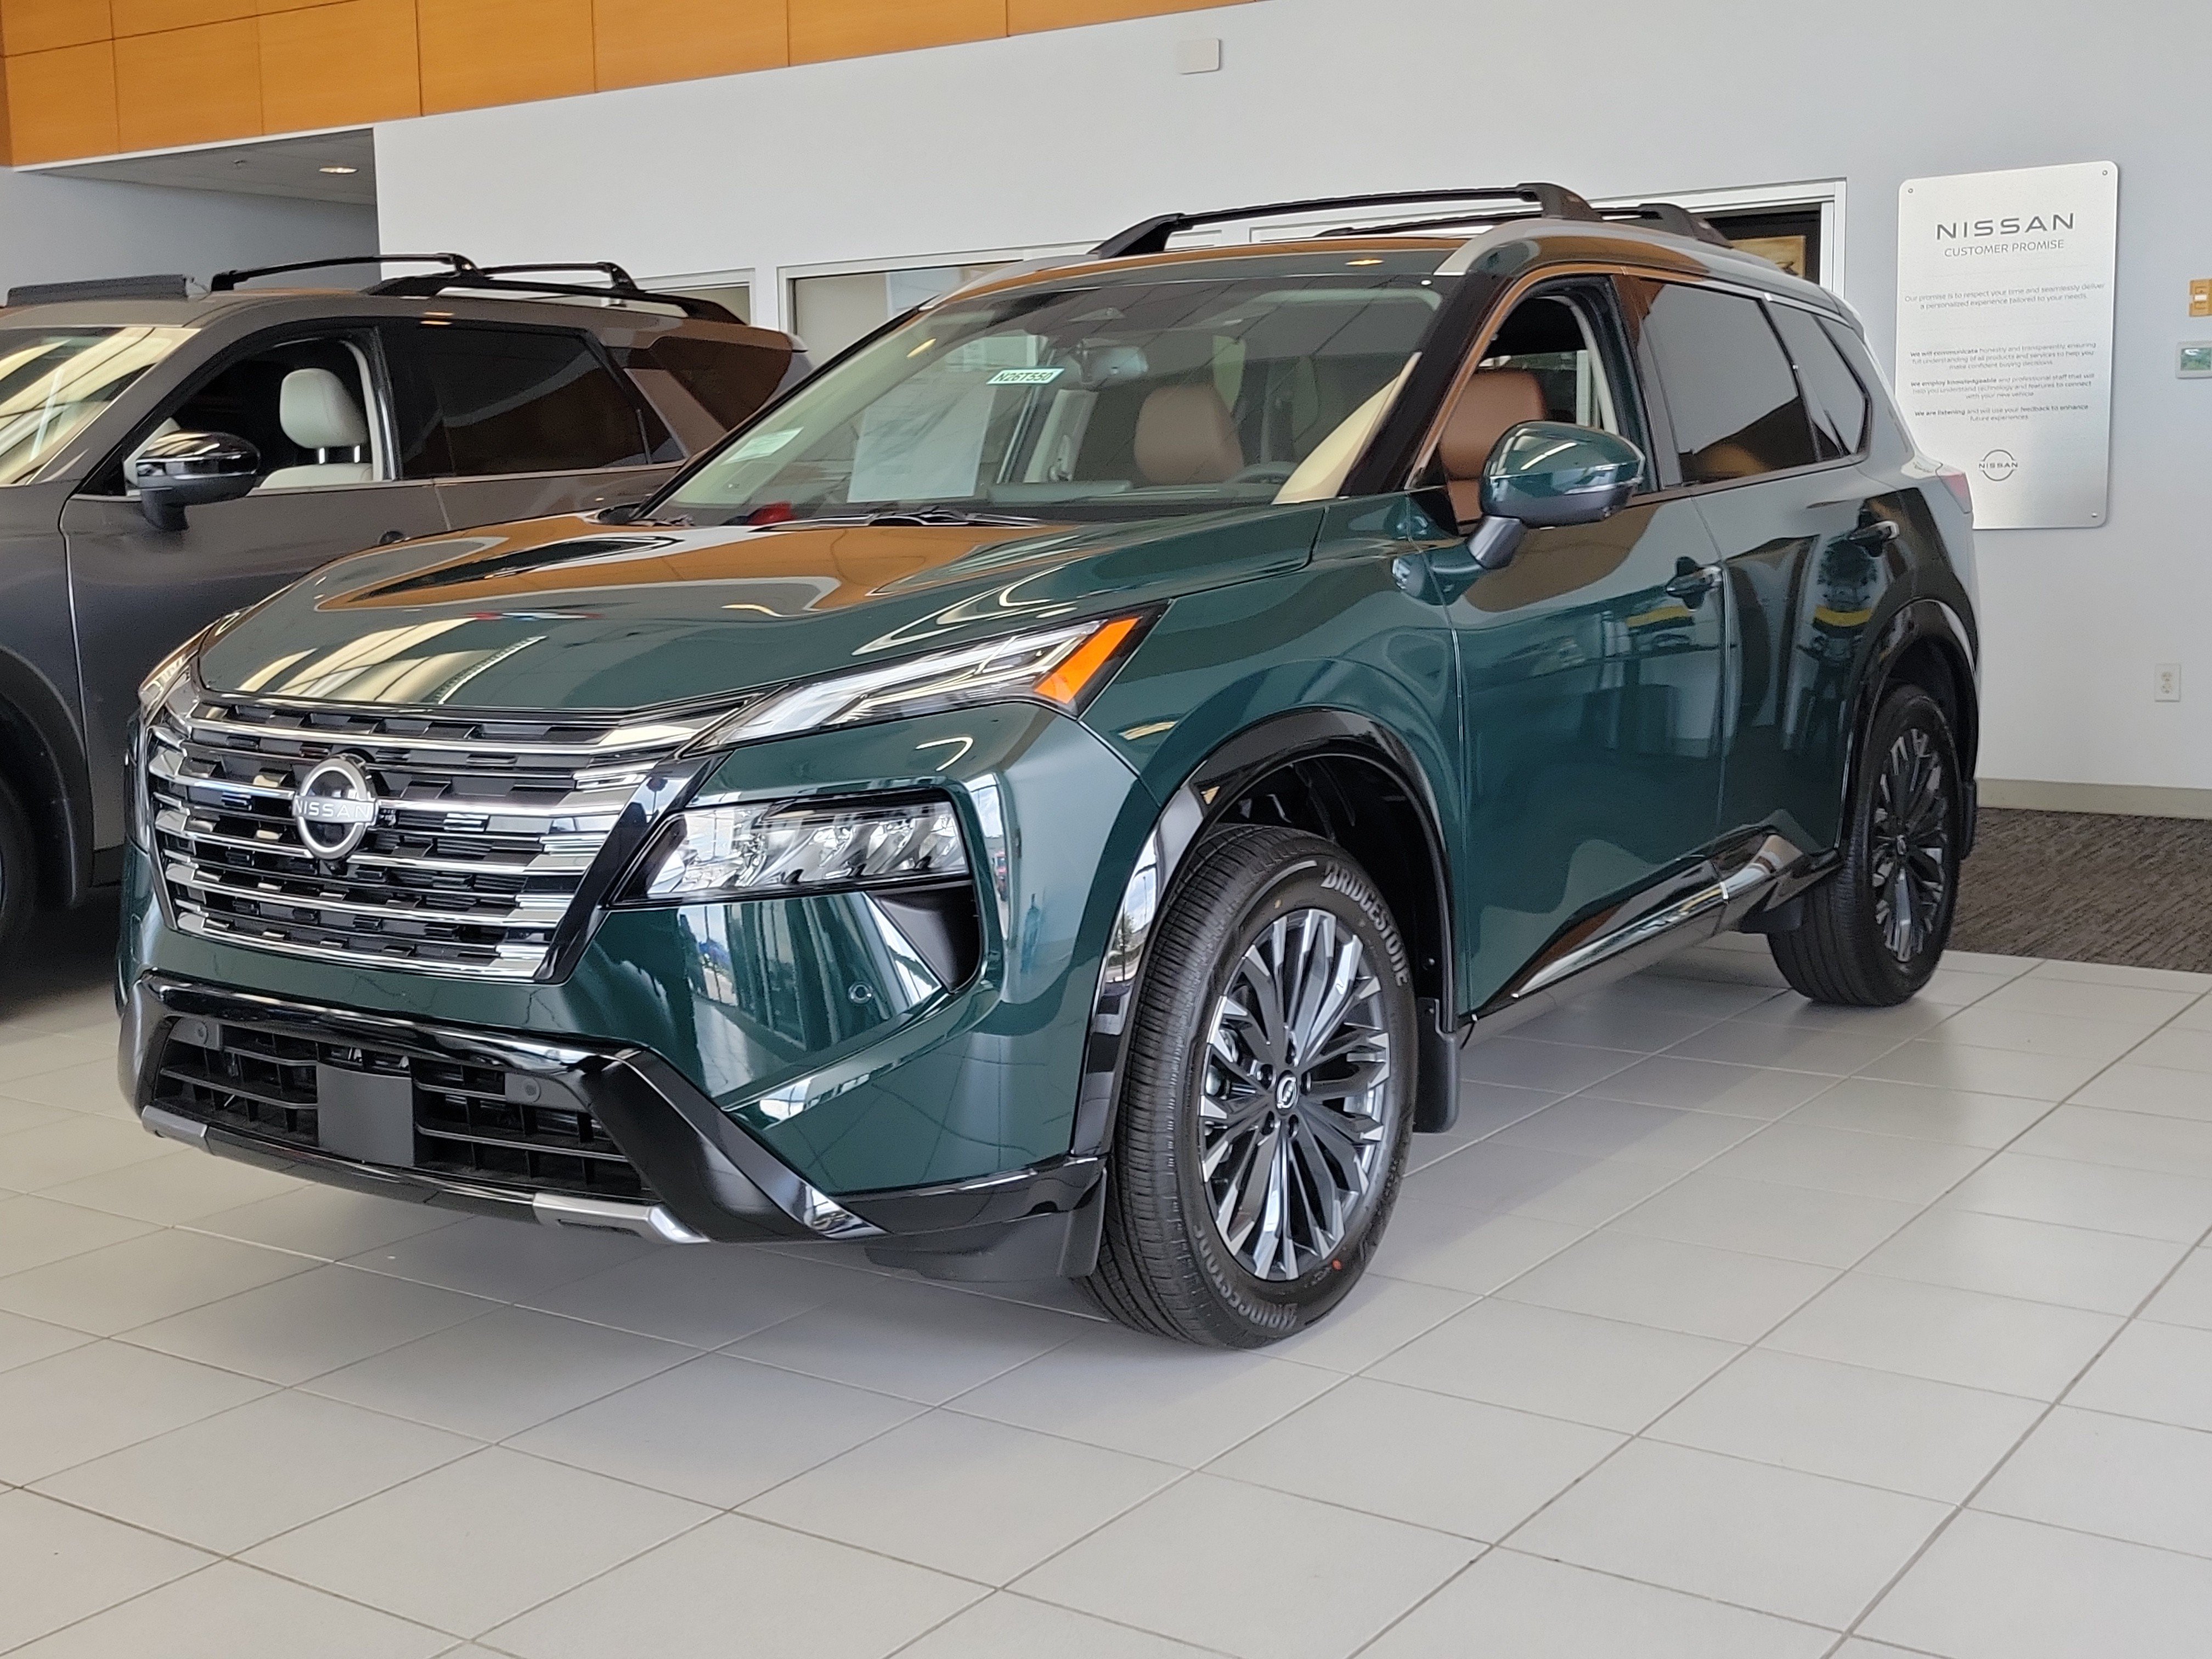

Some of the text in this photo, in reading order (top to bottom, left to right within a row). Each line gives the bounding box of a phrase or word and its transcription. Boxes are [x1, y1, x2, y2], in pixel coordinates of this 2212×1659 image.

[1937, 212, 2074, 240] NISSAN
[1944, 239, 2064, 257] CUSTOMER PROMISE
[295, 799, 370, 819] NISSAN
[1321, 860, 1409, 986] BRIDGESTONE
